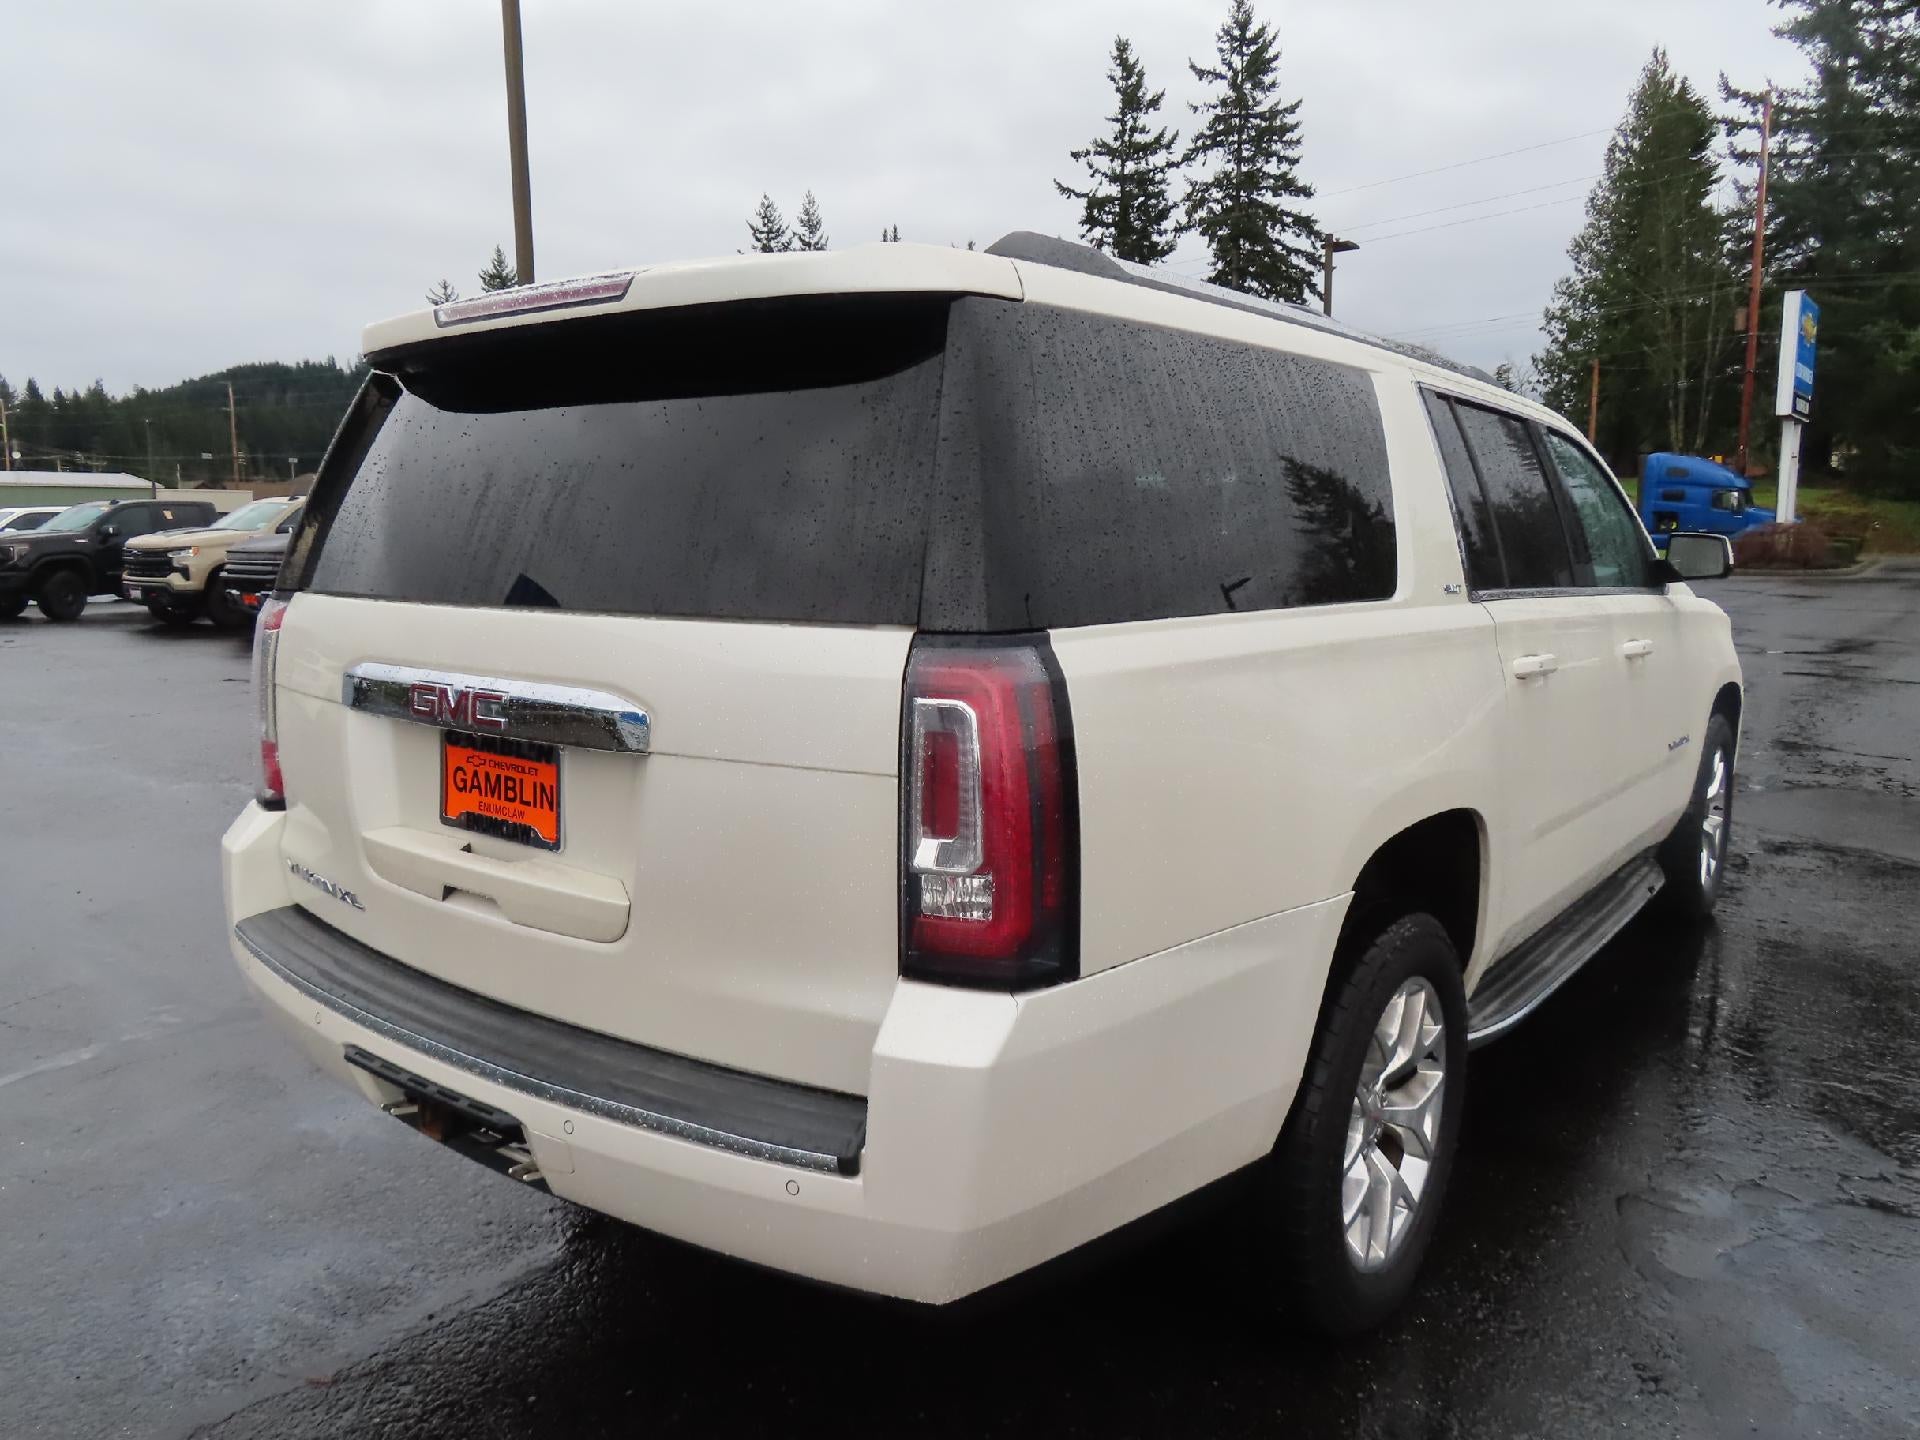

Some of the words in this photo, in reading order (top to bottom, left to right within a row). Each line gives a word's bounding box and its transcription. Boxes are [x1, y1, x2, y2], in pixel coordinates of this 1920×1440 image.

[411, 681, 509, 730] GMC
[488, 759, 539, 777] CHEVROLET
[453, 766, 554, 812] GAMBLIN
[478, 801, 525, 820] ENUMCLAW
